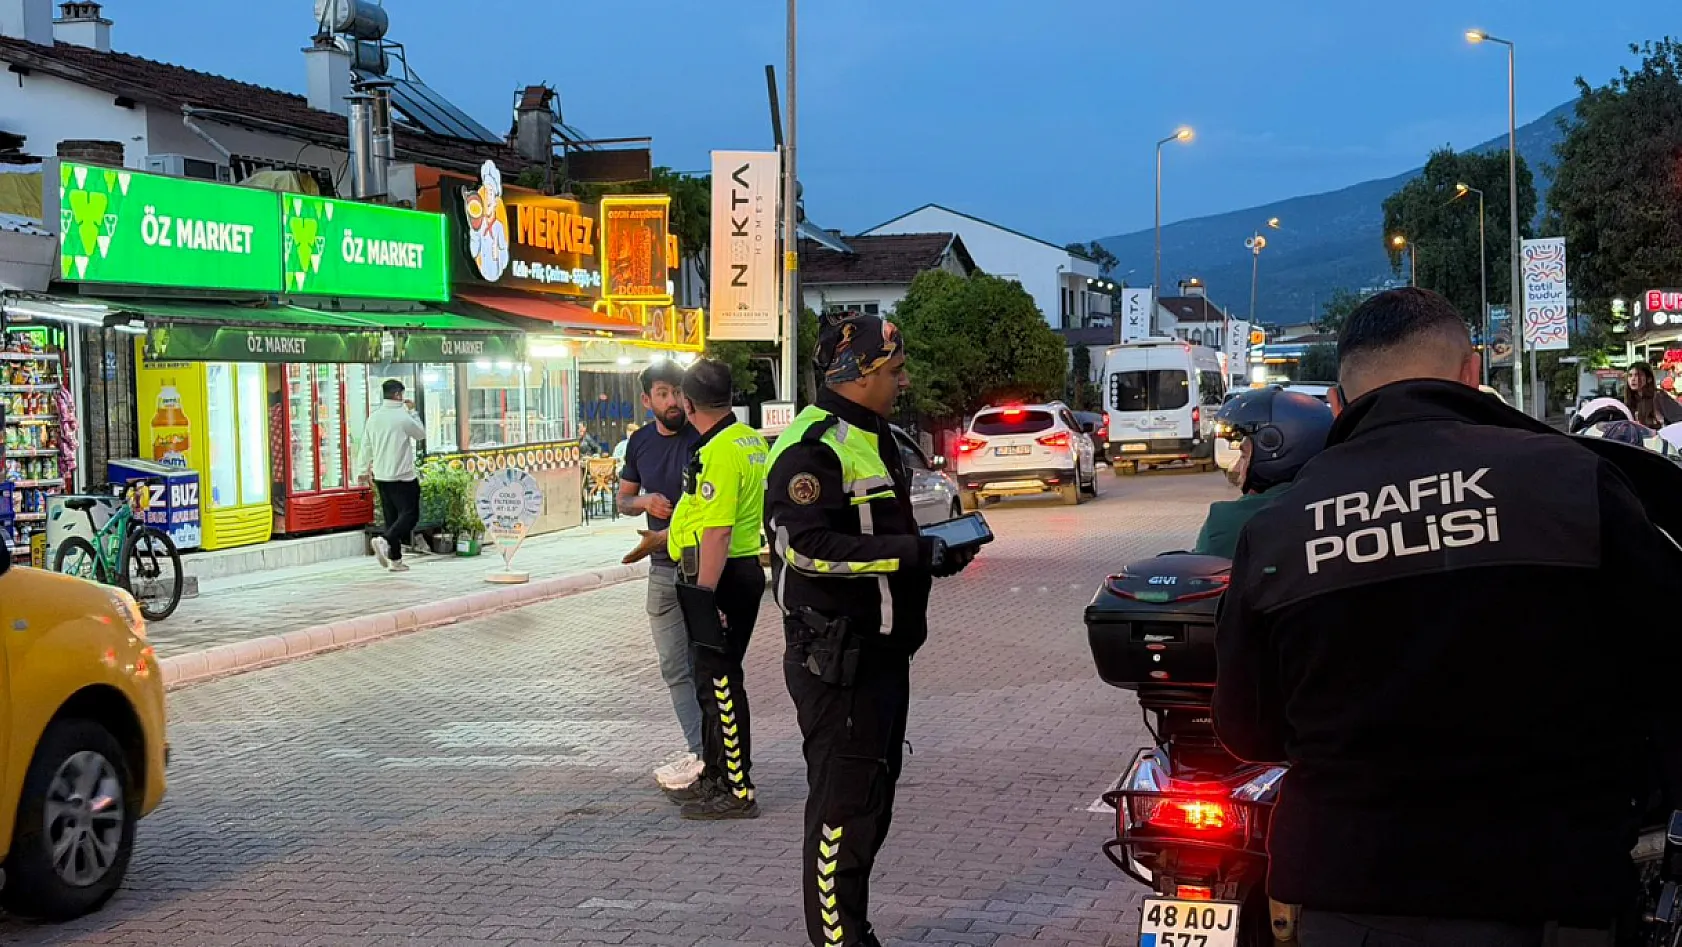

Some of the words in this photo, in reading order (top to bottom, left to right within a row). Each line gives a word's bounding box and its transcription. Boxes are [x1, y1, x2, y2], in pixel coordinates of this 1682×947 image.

[141, 204, 172, 246] ÖZ
[176, 217, 254, 254] MARKET
[517, 203, 594, 255] MERKEZ
[755, 195, 764, 255] HOMES
[342, 228, 365, 263] ÖZ
[367, 238, 424, 269] MARKET
[618, 282, 654, 295] DÖNER
[1529, 291, 1563, 300] budur
[247, 331, 263, 352] ÖZ
[264, 336, 306, 354] MARKET
[454, 340, 485, 355] MARKET
[766, 409, 791, 425] KELLE
[171, 483, 199, 508] BUZ
[1148, 577, 1178, 585] GIVI
[1147, 904, 1178, 928] 48
[1161, 932, 1208, 947] 577
